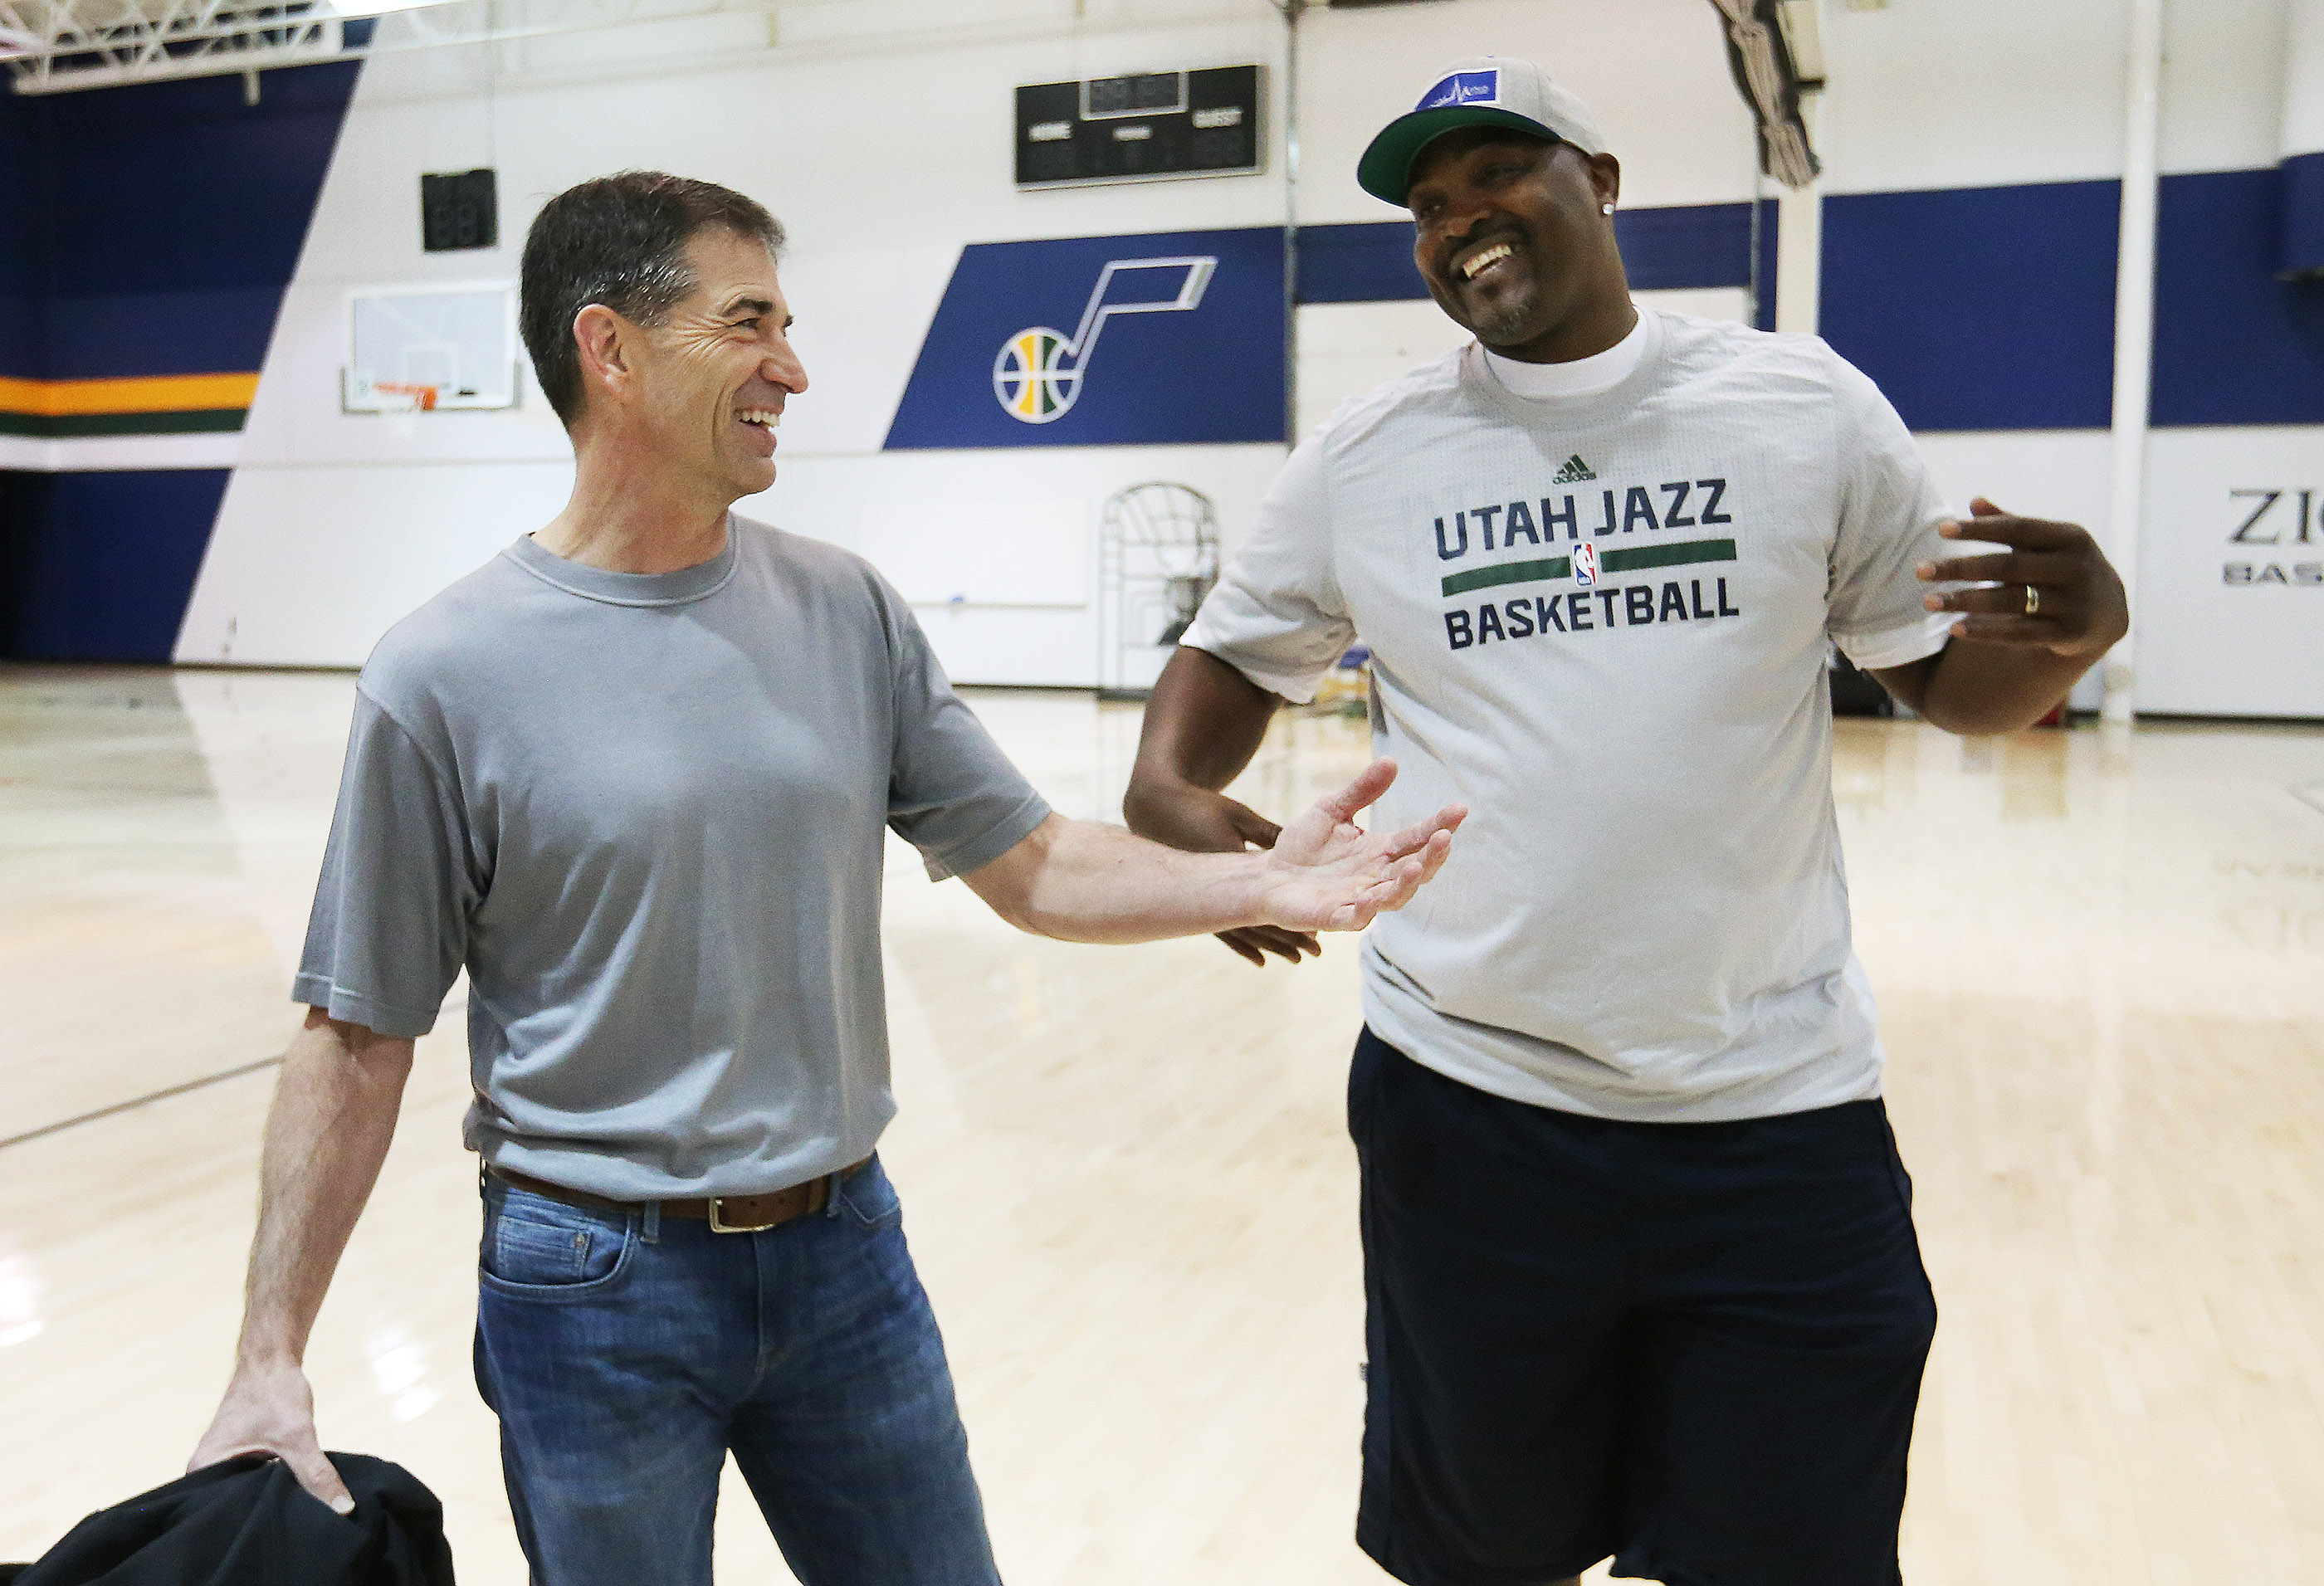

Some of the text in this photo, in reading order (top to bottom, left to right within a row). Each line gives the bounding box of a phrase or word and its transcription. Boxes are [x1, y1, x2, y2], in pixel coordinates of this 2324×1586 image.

[1434, 478, 1731, 560] UTAH JAZZ
[2229, 488, 2324, 544] ZI
[1444, 577, 1739, 650] BASKETBALL
